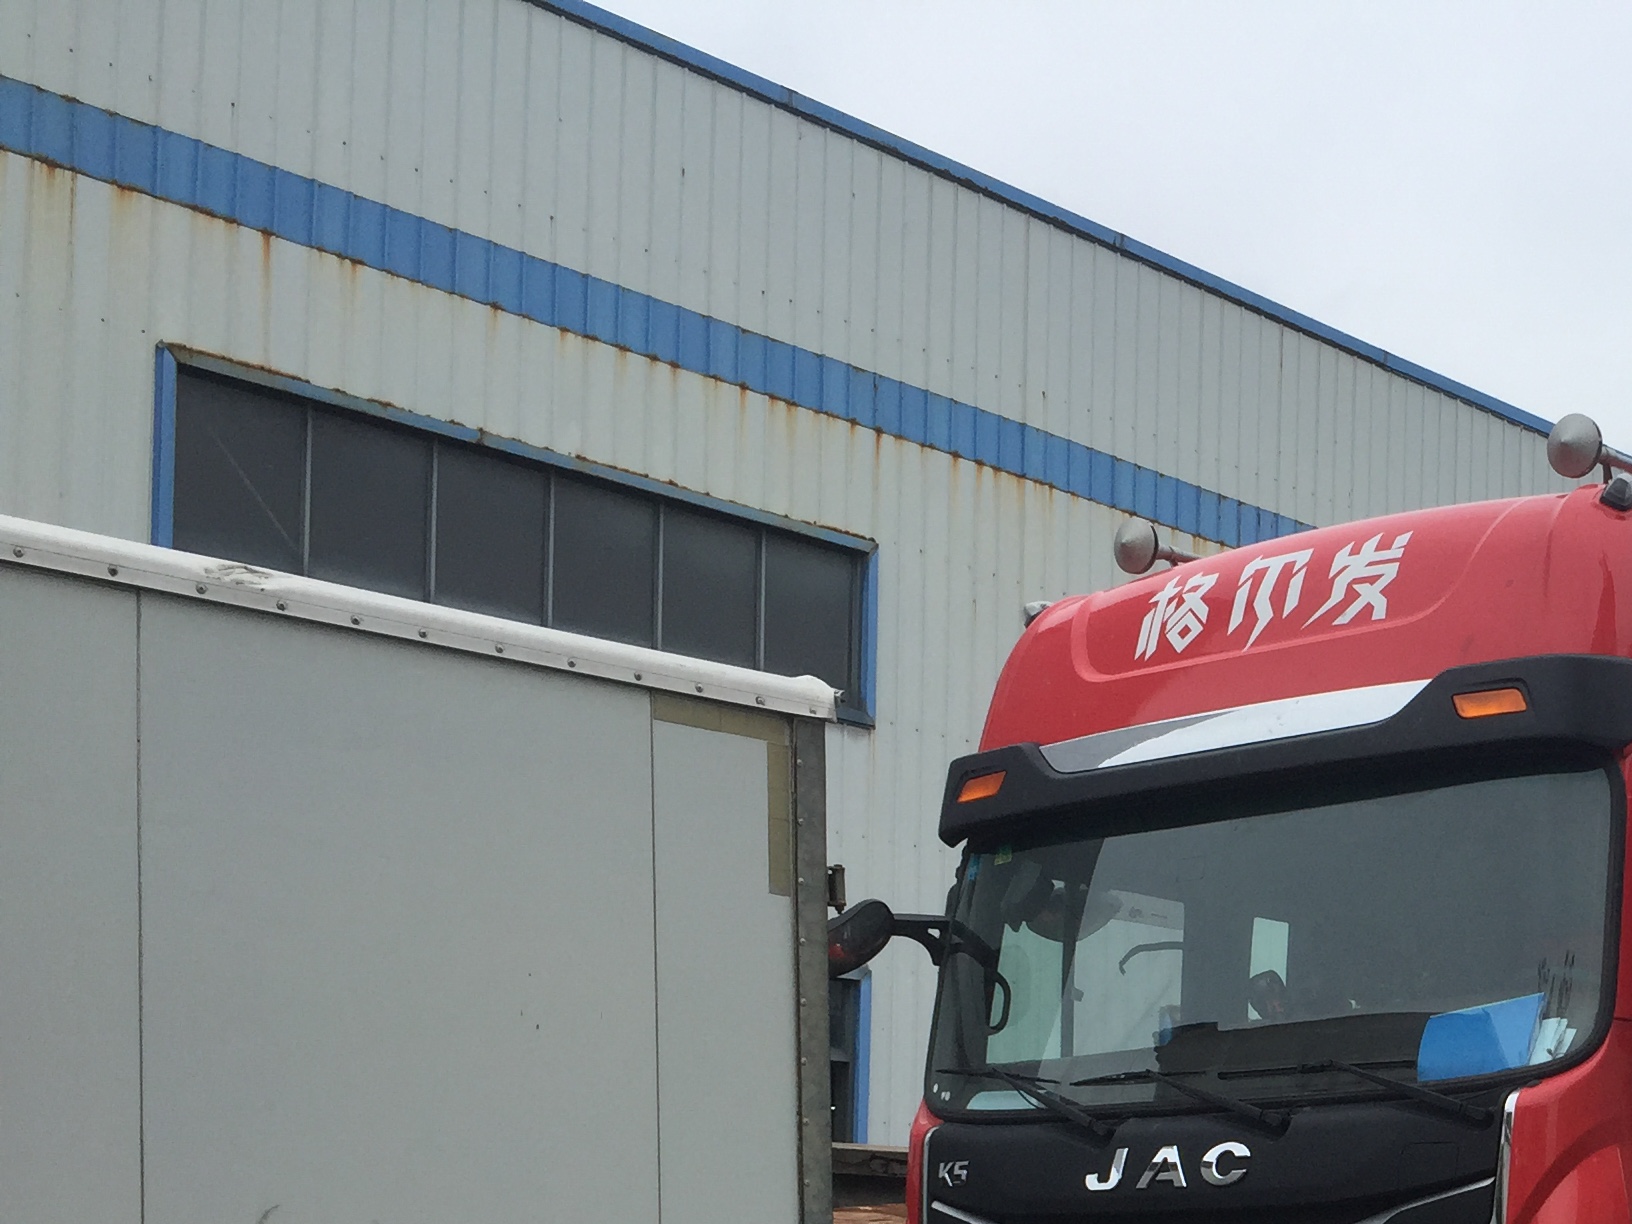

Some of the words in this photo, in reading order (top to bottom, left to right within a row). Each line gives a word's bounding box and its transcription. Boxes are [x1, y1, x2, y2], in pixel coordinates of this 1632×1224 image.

[1134, 531, 1413, 661] 格尔发
[938, 1160, 969, 1187] K5
[1085, 1141, 1251, 1191] JAC
